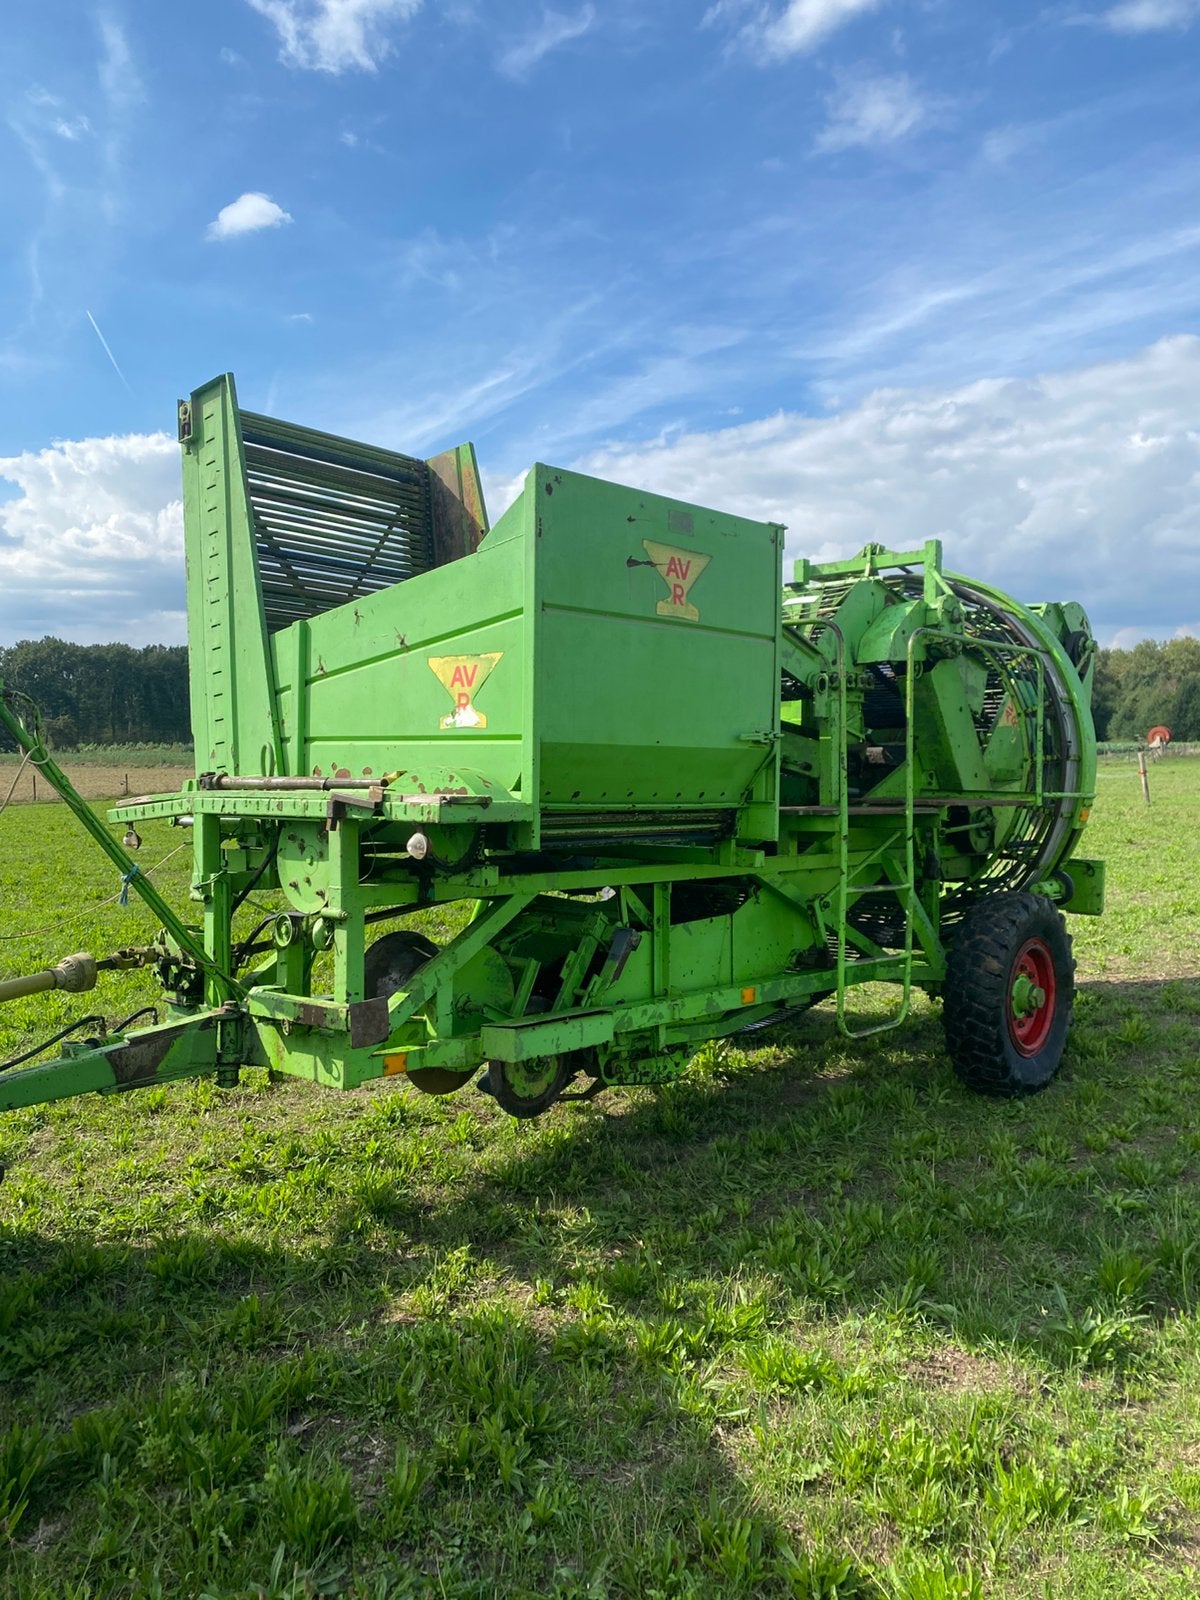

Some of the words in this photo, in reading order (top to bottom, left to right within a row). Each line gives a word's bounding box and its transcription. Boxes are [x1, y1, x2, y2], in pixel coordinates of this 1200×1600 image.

[665, 556, 692, 581] AV
[672, 583, 685, 606] R
[449, 664, 478, 688] AV
